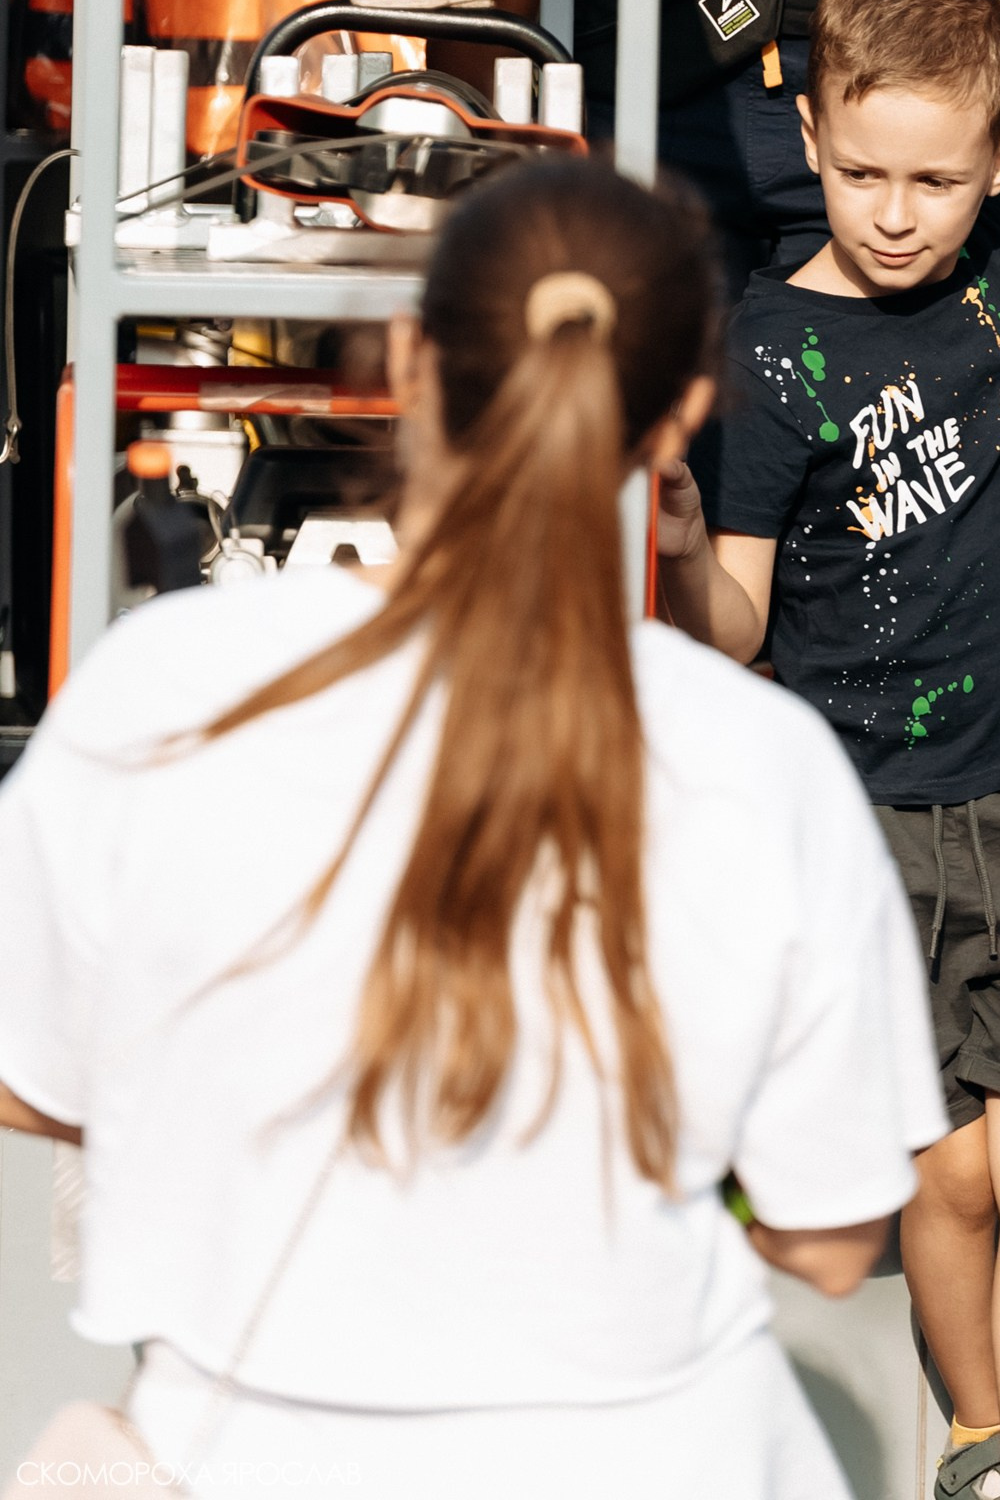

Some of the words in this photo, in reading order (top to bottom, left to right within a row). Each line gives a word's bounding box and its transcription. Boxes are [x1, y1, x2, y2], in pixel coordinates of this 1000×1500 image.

[849, 379, 925, 470] FUN
[871, 452, 901, 491] IN
[906, 417, 961, 464] THE
[846, 451, 976, 542] WAVE
